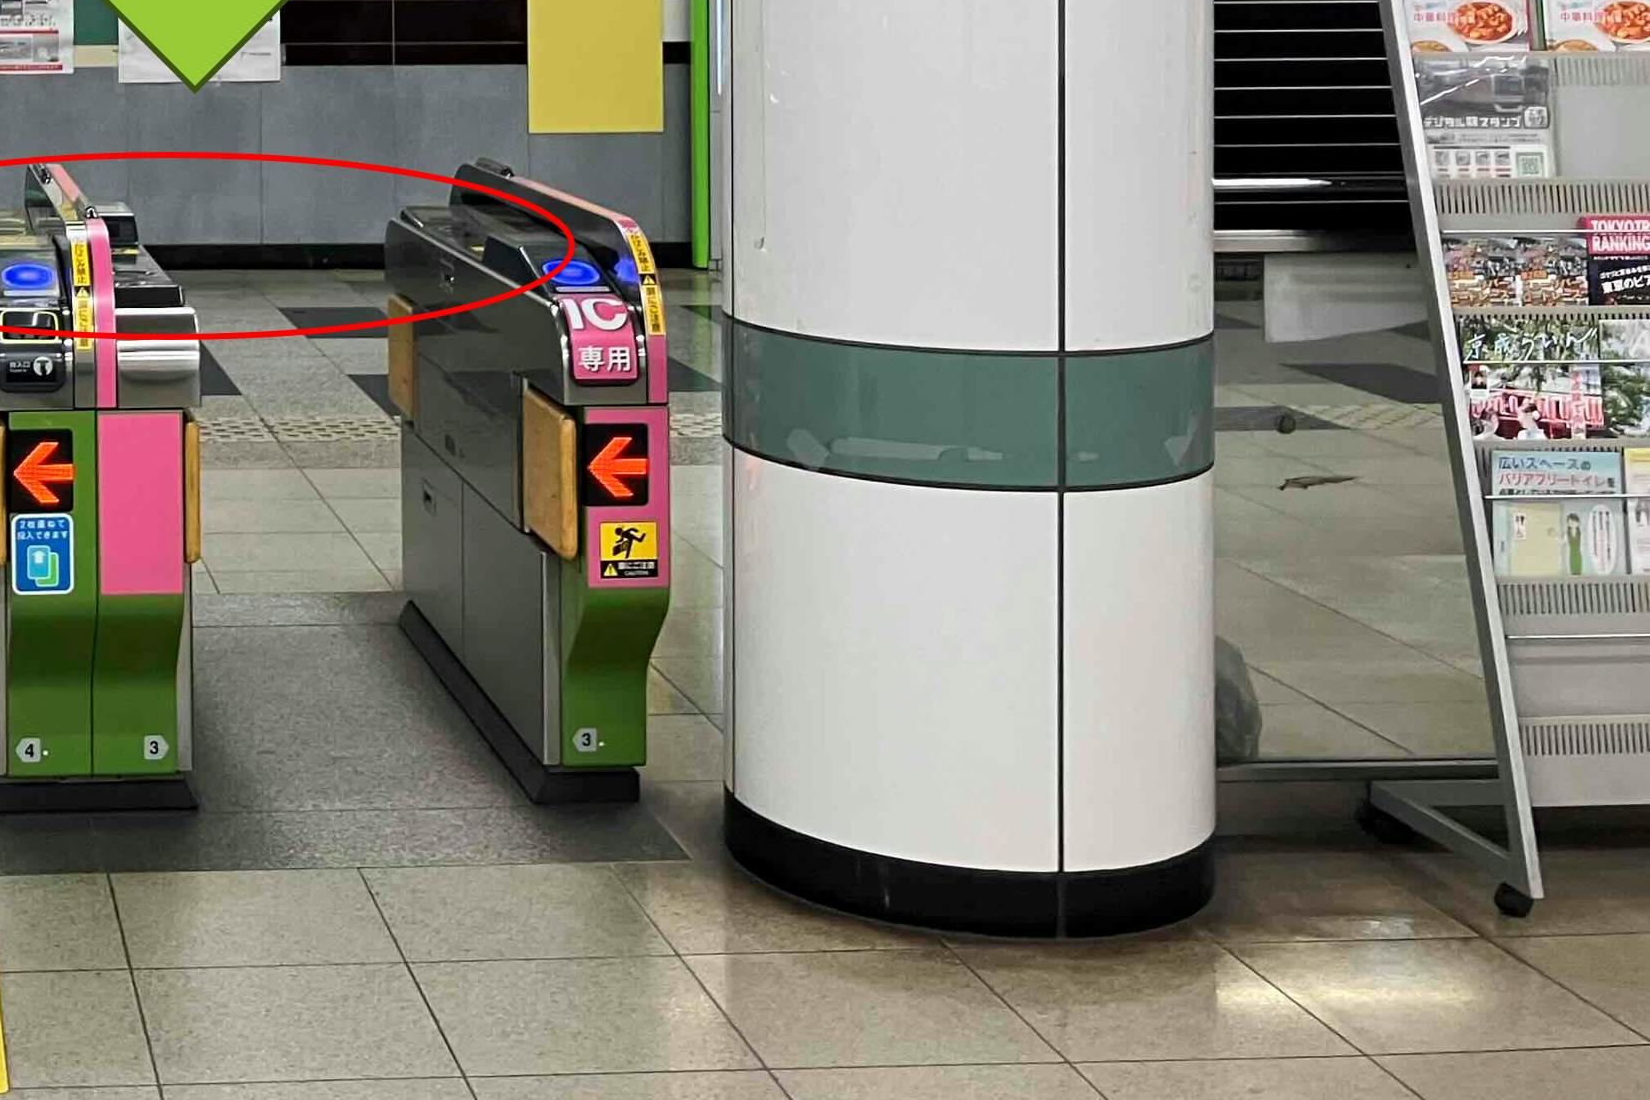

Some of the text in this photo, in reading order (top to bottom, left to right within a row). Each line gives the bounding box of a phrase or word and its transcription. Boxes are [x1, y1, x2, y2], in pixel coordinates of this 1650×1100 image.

[1592, 234, 1650, 253] RANKING
[562, 298, 628, 331] IC
[578, 345, 631, 372] 専用
[149, 740, 159, 755] 3
[582, 732, 592, 747] 3
[24, 743, 35, 758] 4
